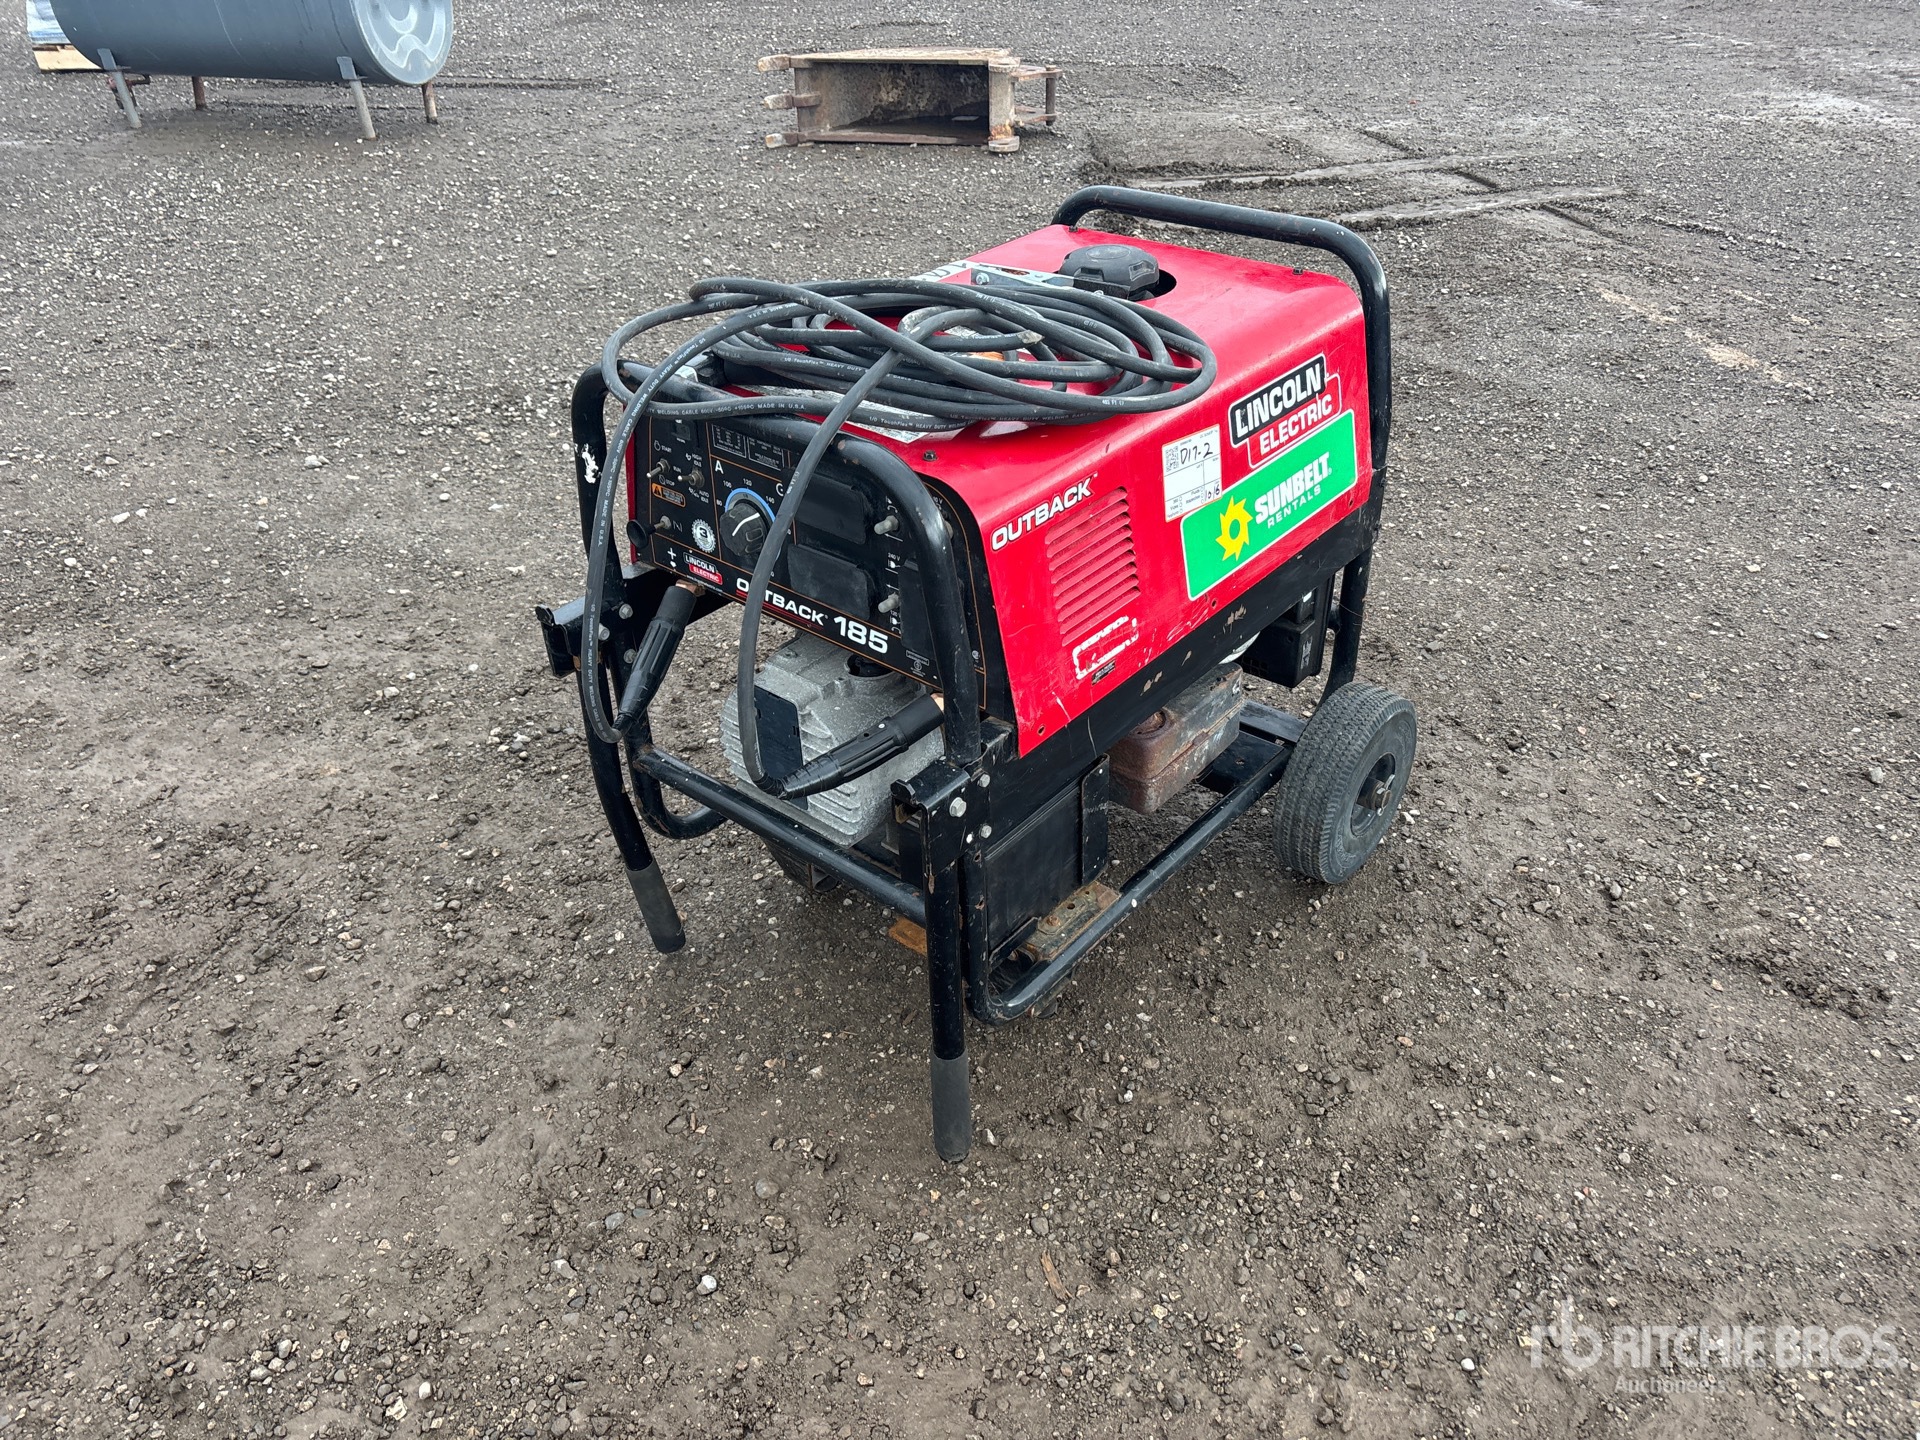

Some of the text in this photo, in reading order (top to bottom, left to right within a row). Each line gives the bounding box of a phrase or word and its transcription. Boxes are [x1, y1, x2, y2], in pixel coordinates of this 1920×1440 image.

[659, 364, 674, 379] HEAVY
[826, 362, 845, 370] HEAVY
[647, 379, 659, 393] DUTY
[631, 393, 648, 417] WELDING
[1233, 362, 1322, 438] LINCOLN
[681, 408, 699, 416] CABLE
[621, 418, 633, 437] CABLE
[1259, 393, 1333, 456] ELECTRIC
[715, 460, 724, 475] A
[722, 480, 732, 489] 100
[743, 478, 752, 486] 120
[1254, 452, 1331, 525] SUNBELT
[992, 477, 1093, 551] OUTBACK
[1267, 484, 1322, 529] RENTALS
[600, 519, 606, 527] IN
[699, 526, 708, 538] 3
[685, 555, 715, 573] LINCOLN
[692, 566, 720, 582] ELECTRIC
[736, 578, 889, 654] OTBACK 185
[588, 685, 596, 707] WELDING
